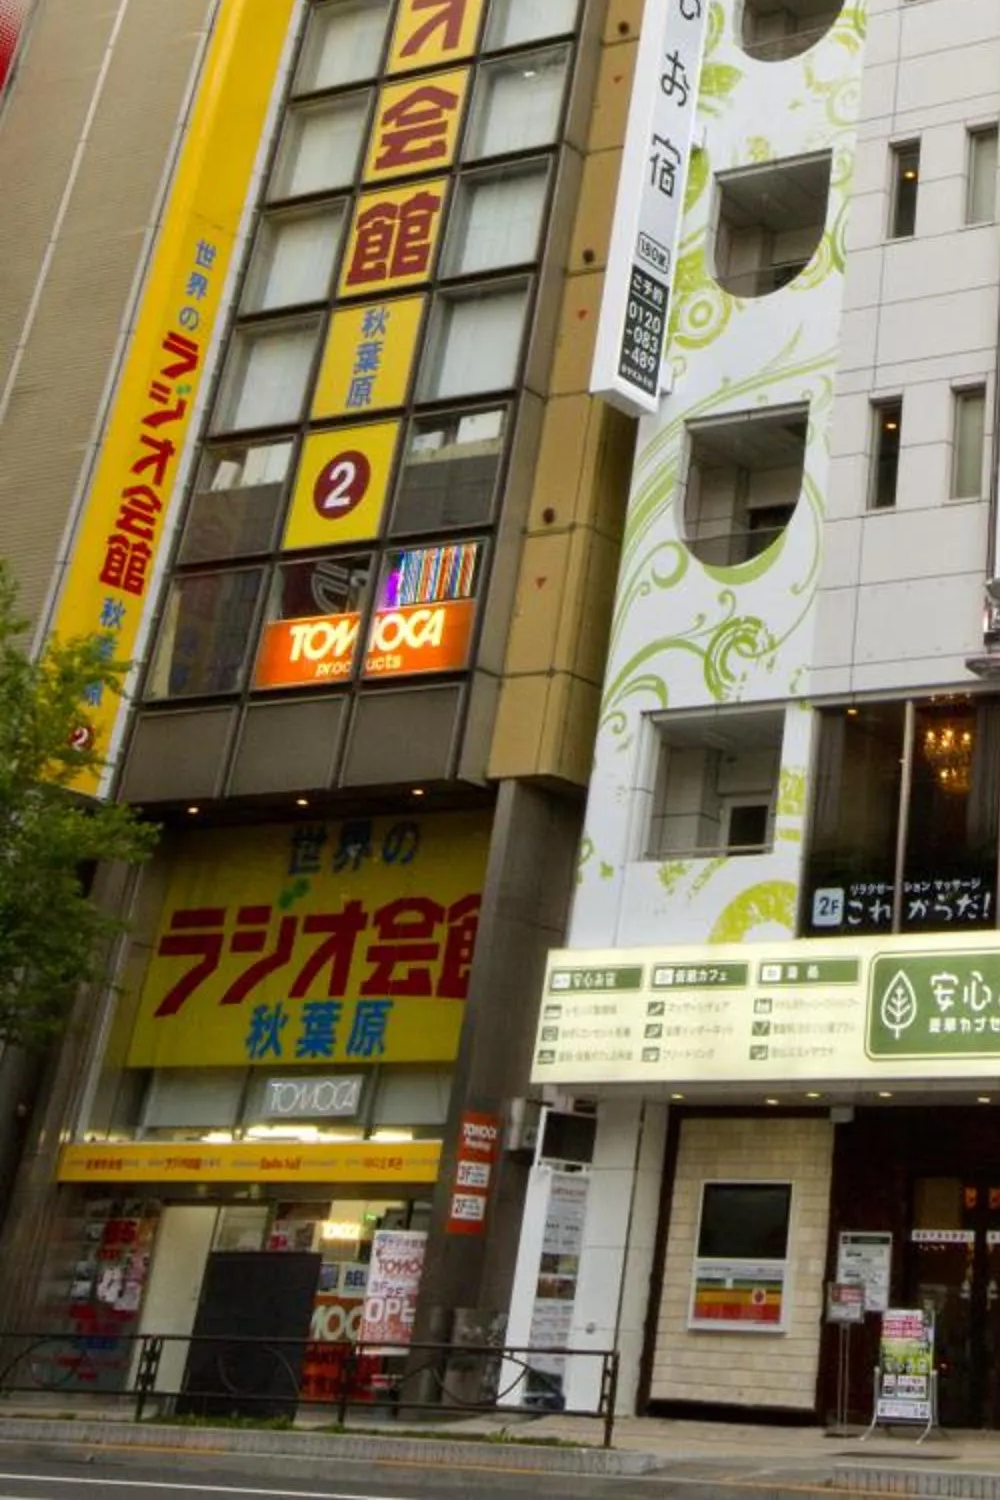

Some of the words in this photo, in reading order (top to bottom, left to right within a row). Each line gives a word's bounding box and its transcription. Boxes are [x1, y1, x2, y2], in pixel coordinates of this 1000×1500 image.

[177, 239, 217, 332] 世界の
[344, 306, 391, 409] 秋葉原
[99, 331, 200, 598] ラジオ会館
[322, 460, 356, 510] 2
[287, 818, 421, 876] 世界の
[818, 896, 840, 917] 2F
[244, 999, 395, 1060] 秋葉原
[270, 1080, 358, 1113] TOMOCA
